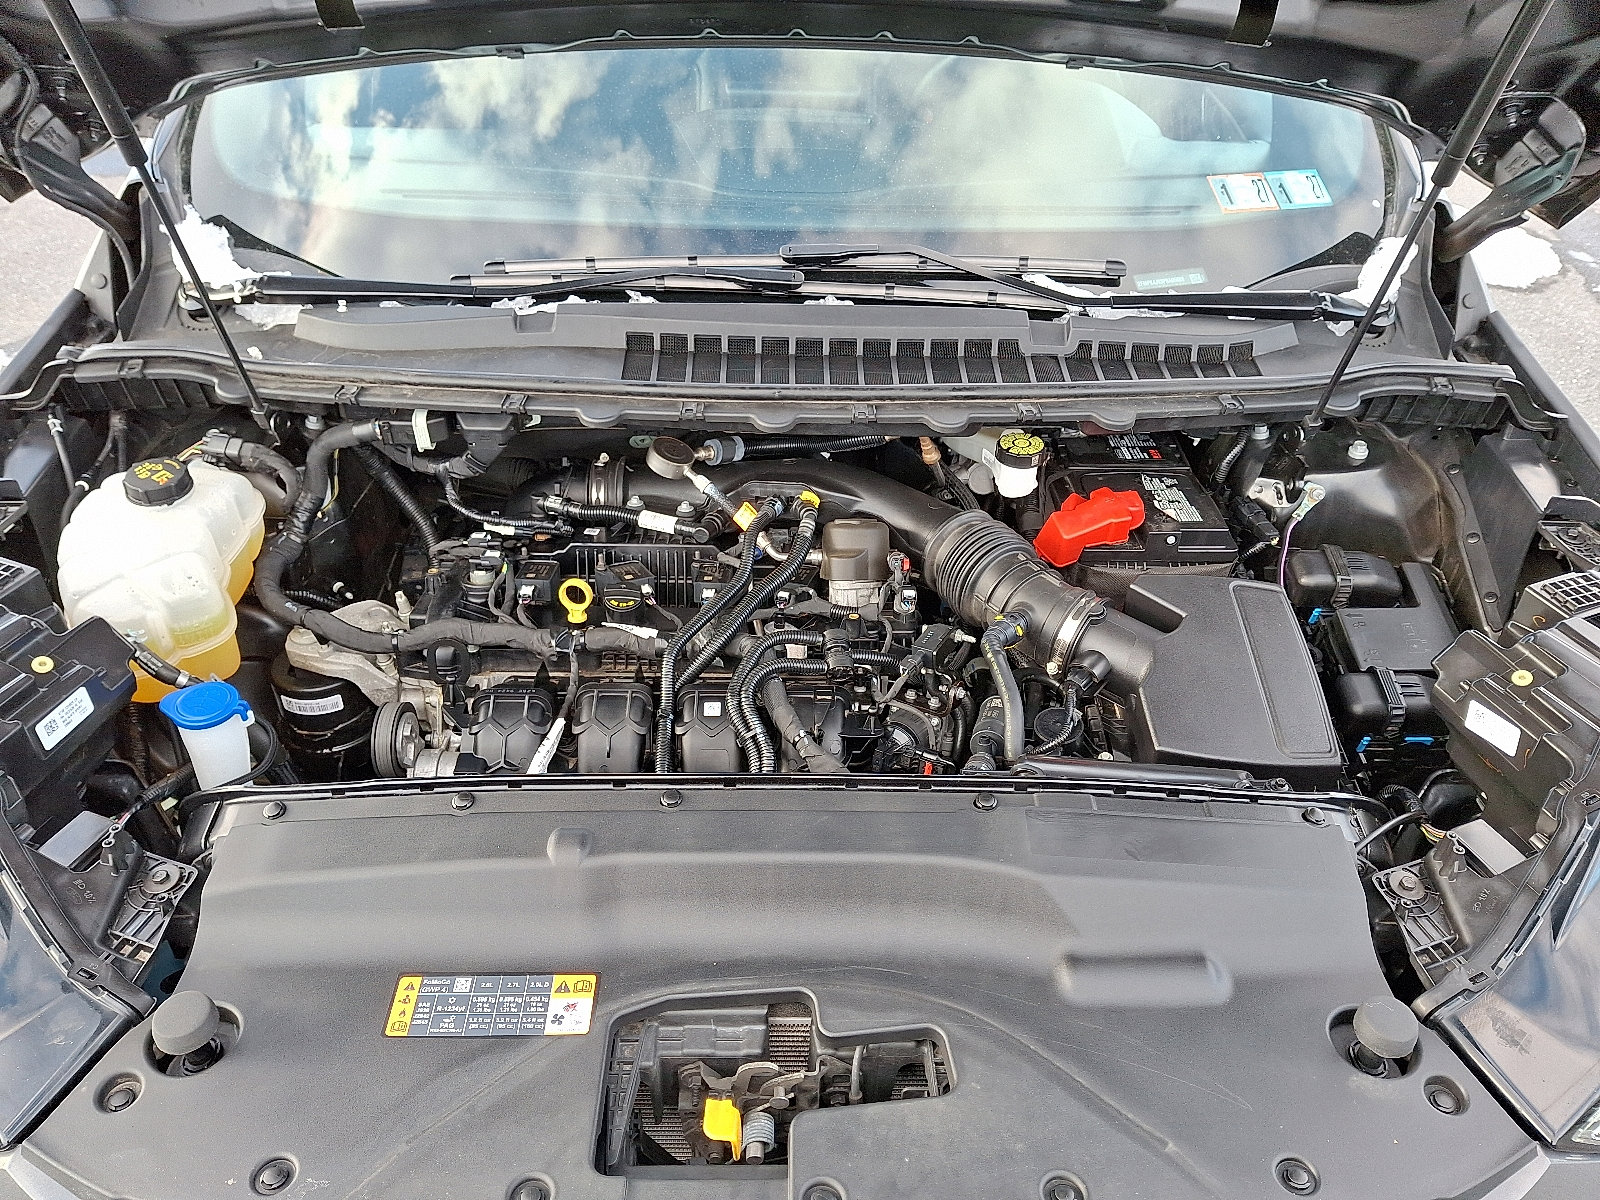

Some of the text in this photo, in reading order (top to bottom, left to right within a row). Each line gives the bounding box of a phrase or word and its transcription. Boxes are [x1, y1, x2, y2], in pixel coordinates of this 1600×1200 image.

[1220, 178, 1270, 205] 1 27
[1278, 174, 1325, 205] 1 27
[436, 1005, 466, 1013] R-1234yf
